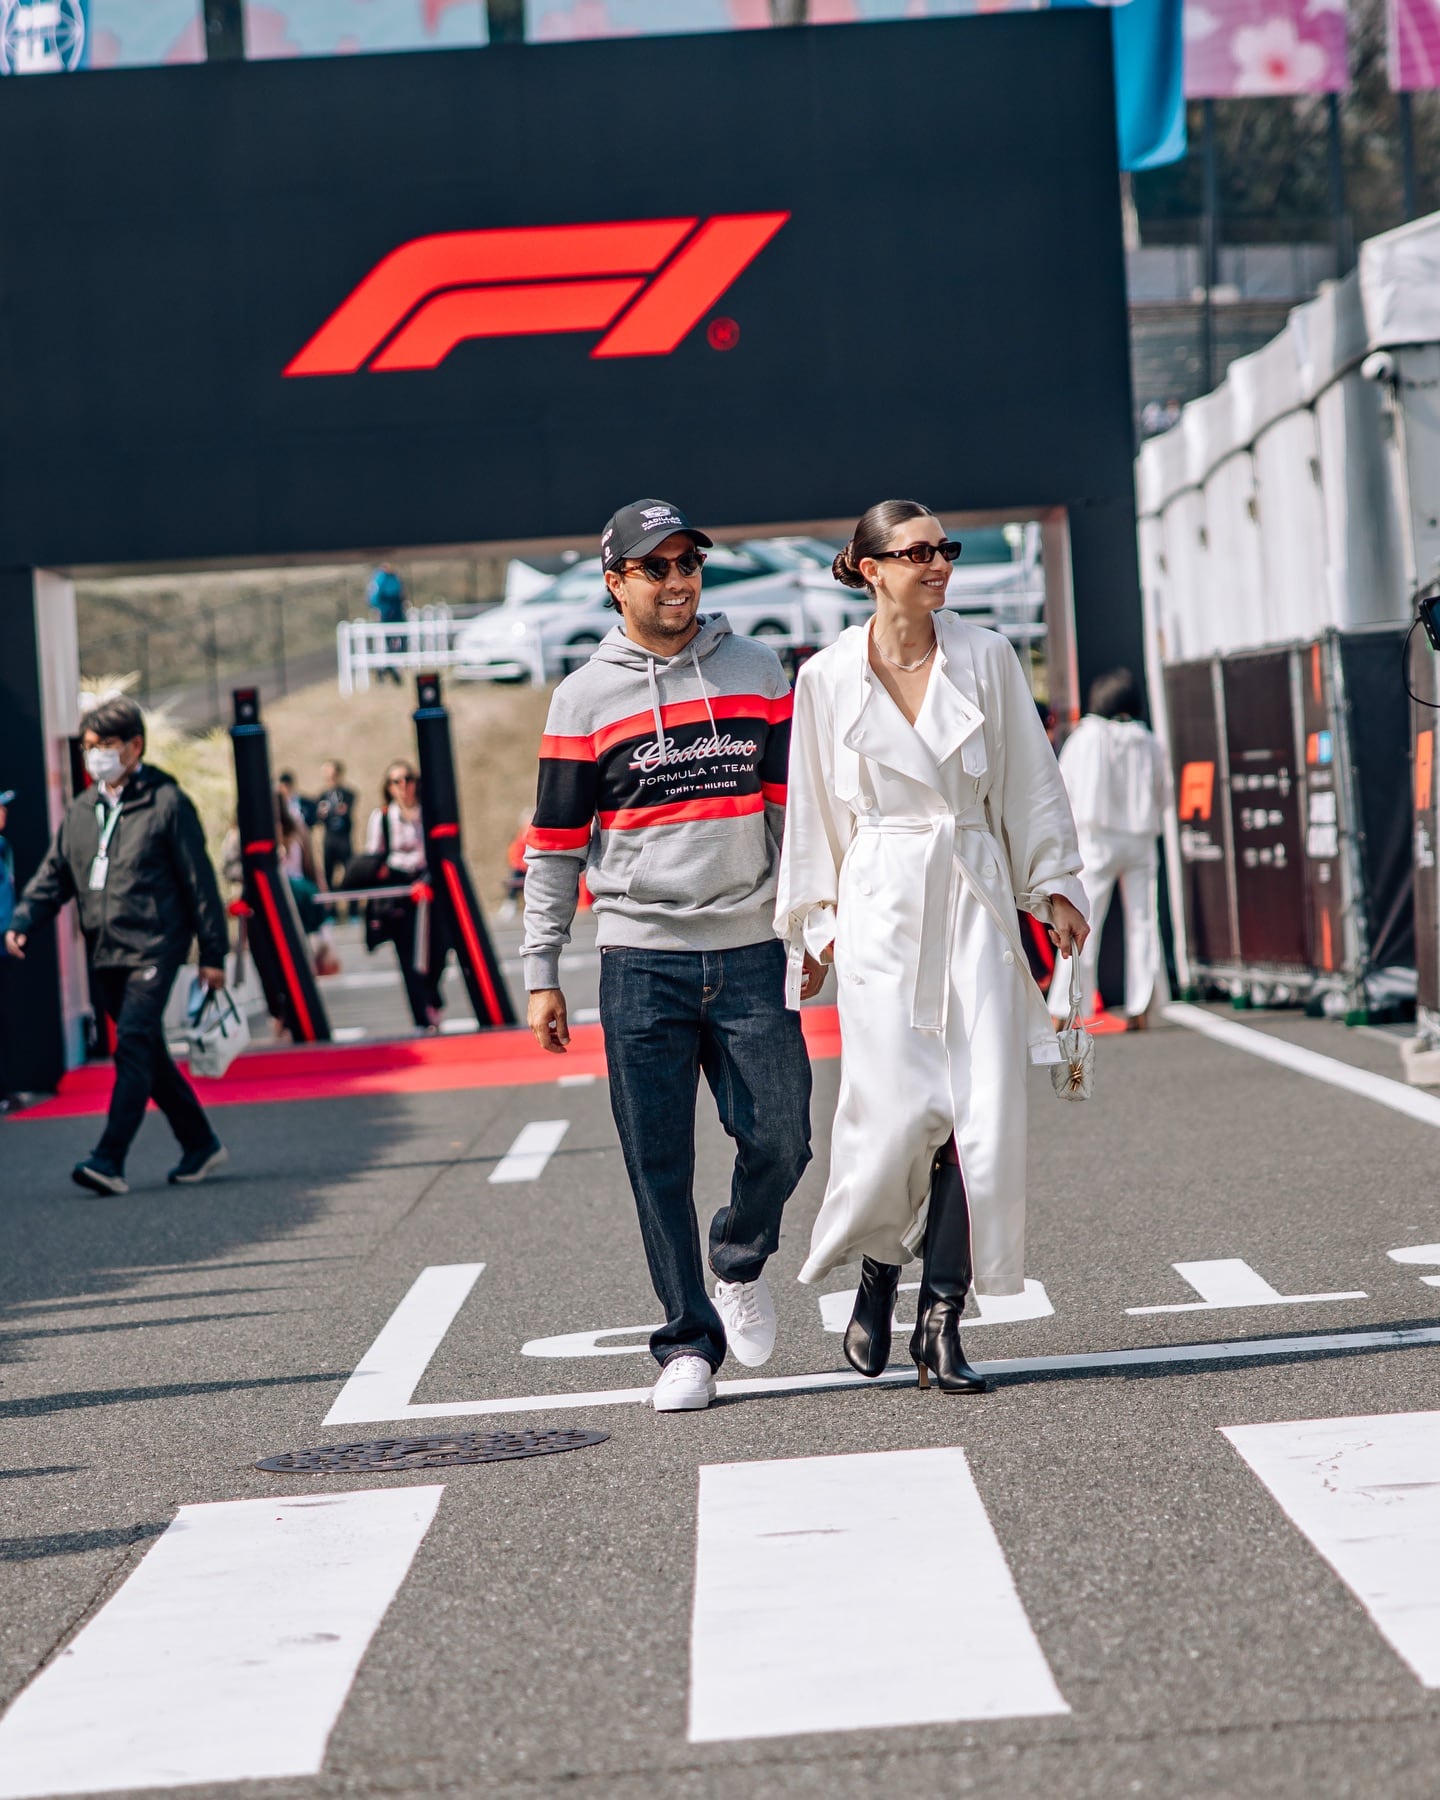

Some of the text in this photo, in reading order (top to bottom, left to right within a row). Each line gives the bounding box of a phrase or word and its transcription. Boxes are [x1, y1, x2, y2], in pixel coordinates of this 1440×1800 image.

[281, 210, 791, 378] F1
[631, 733, 756, 773] Cadillac
[639, 767, 707, 787] FORMULA
[721, 763, 754, 773] TEAM
[665, 781, 738, 795] TOMMY HILFIGER
